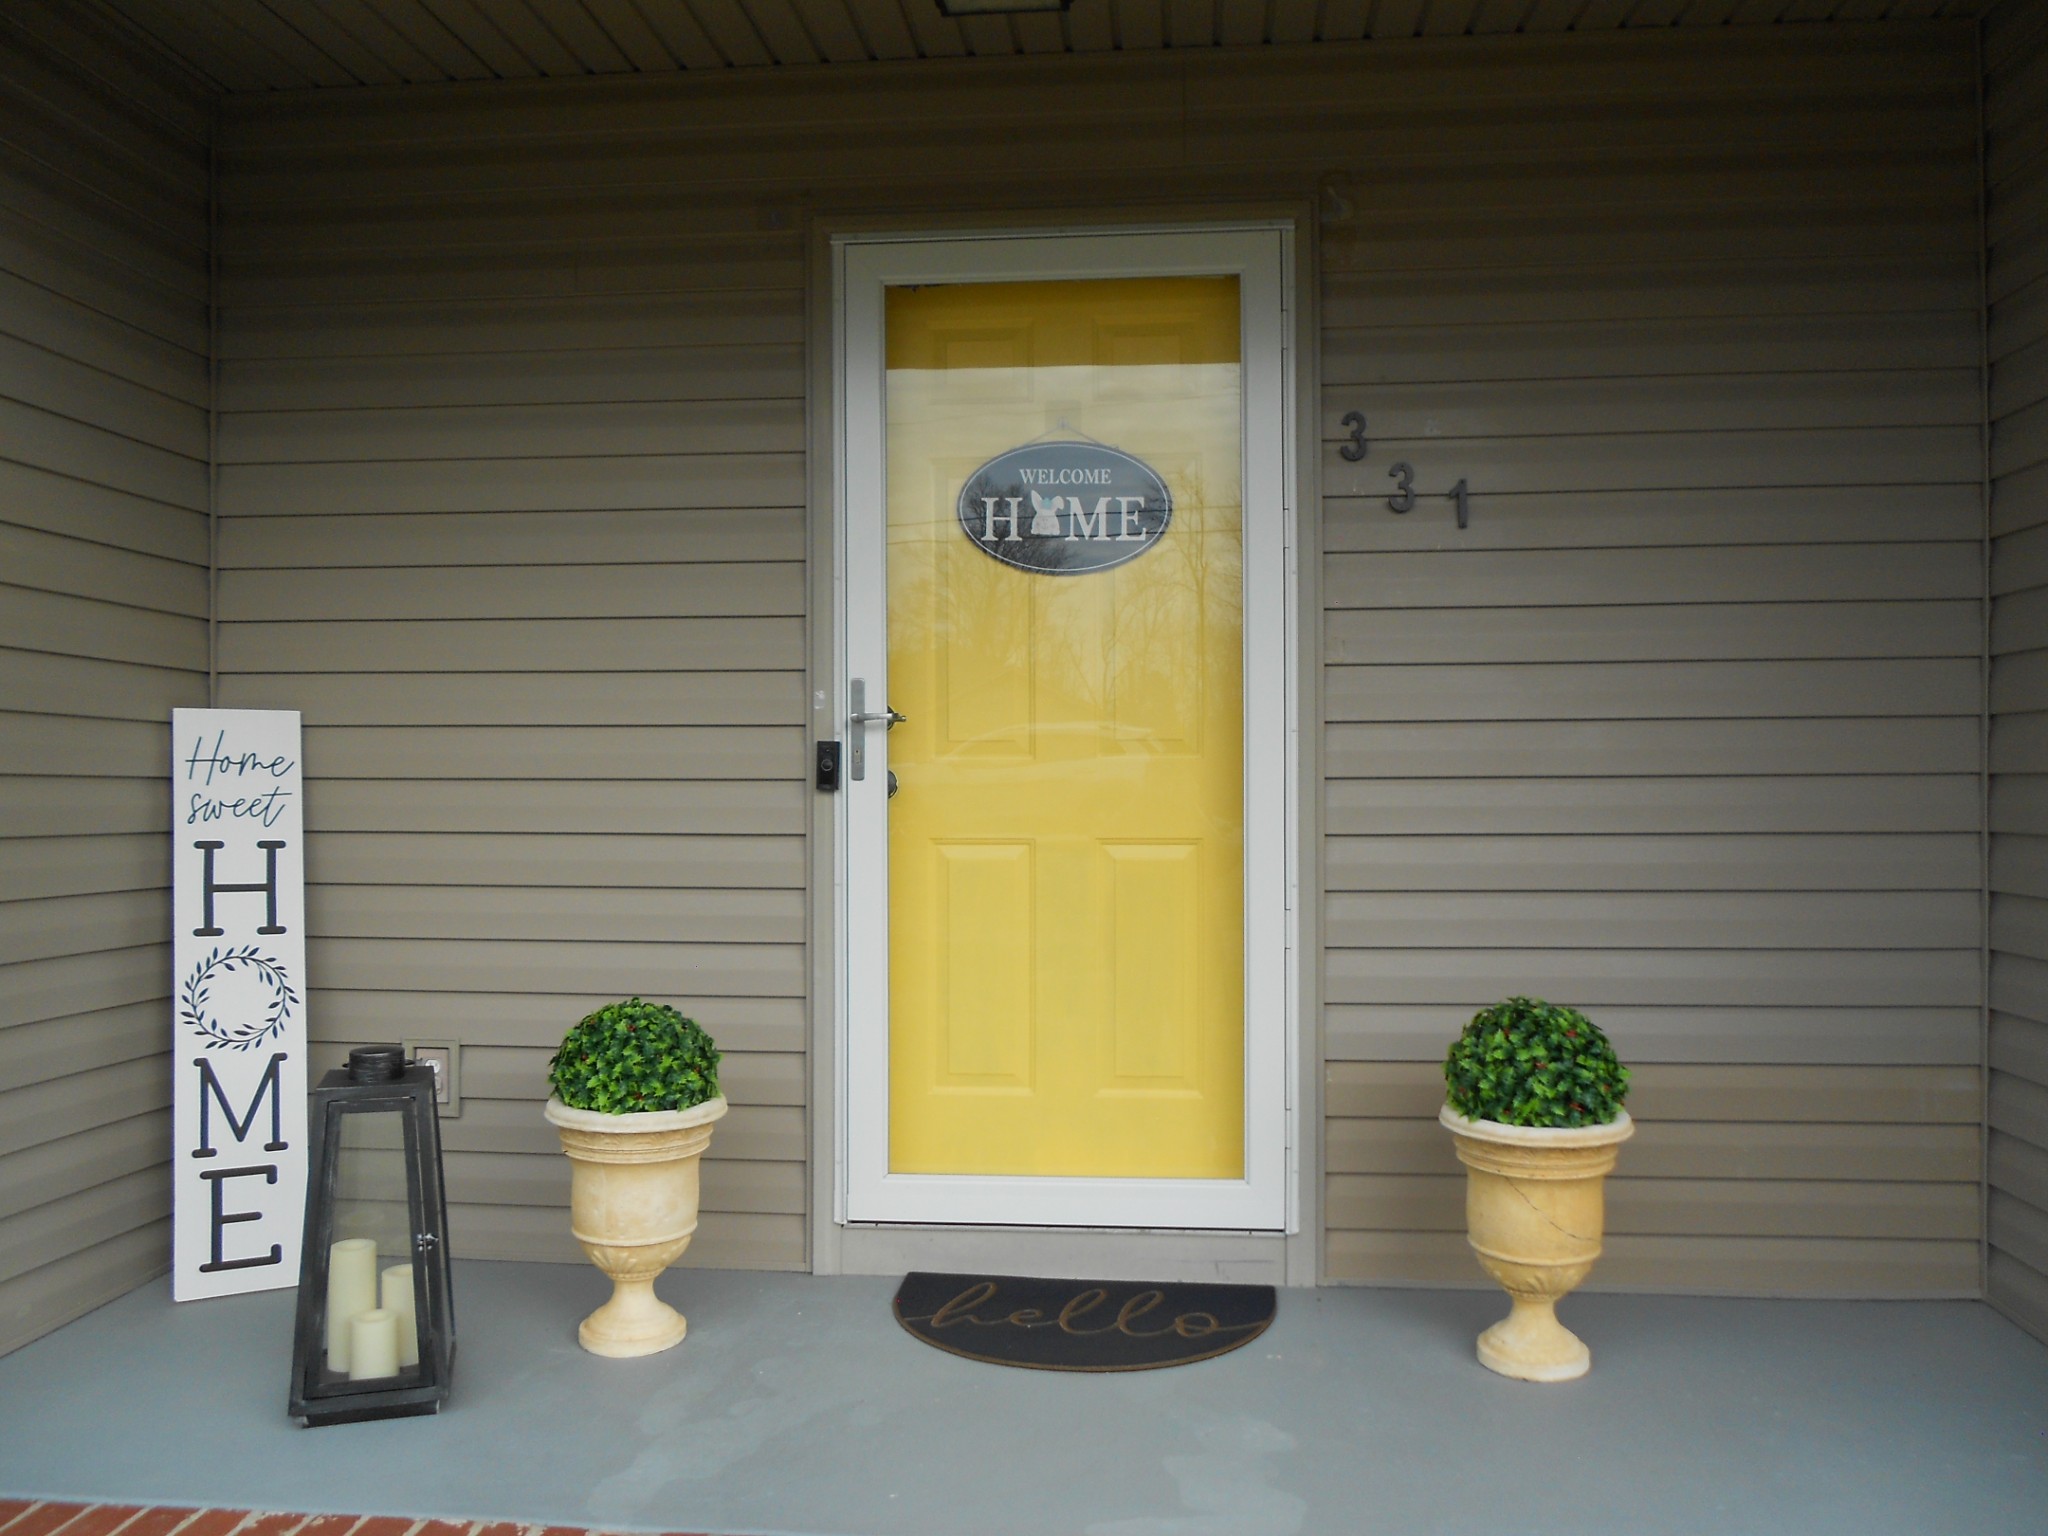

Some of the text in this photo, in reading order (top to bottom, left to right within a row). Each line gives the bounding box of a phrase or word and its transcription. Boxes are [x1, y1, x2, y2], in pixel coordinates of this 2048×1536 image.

[1019, 468, 1112, 485] WELCOME
[185, 729, 295, 786] Home
[187, 786, 293, 828] sweet
[904, 1282, 1266, 1338] hello
